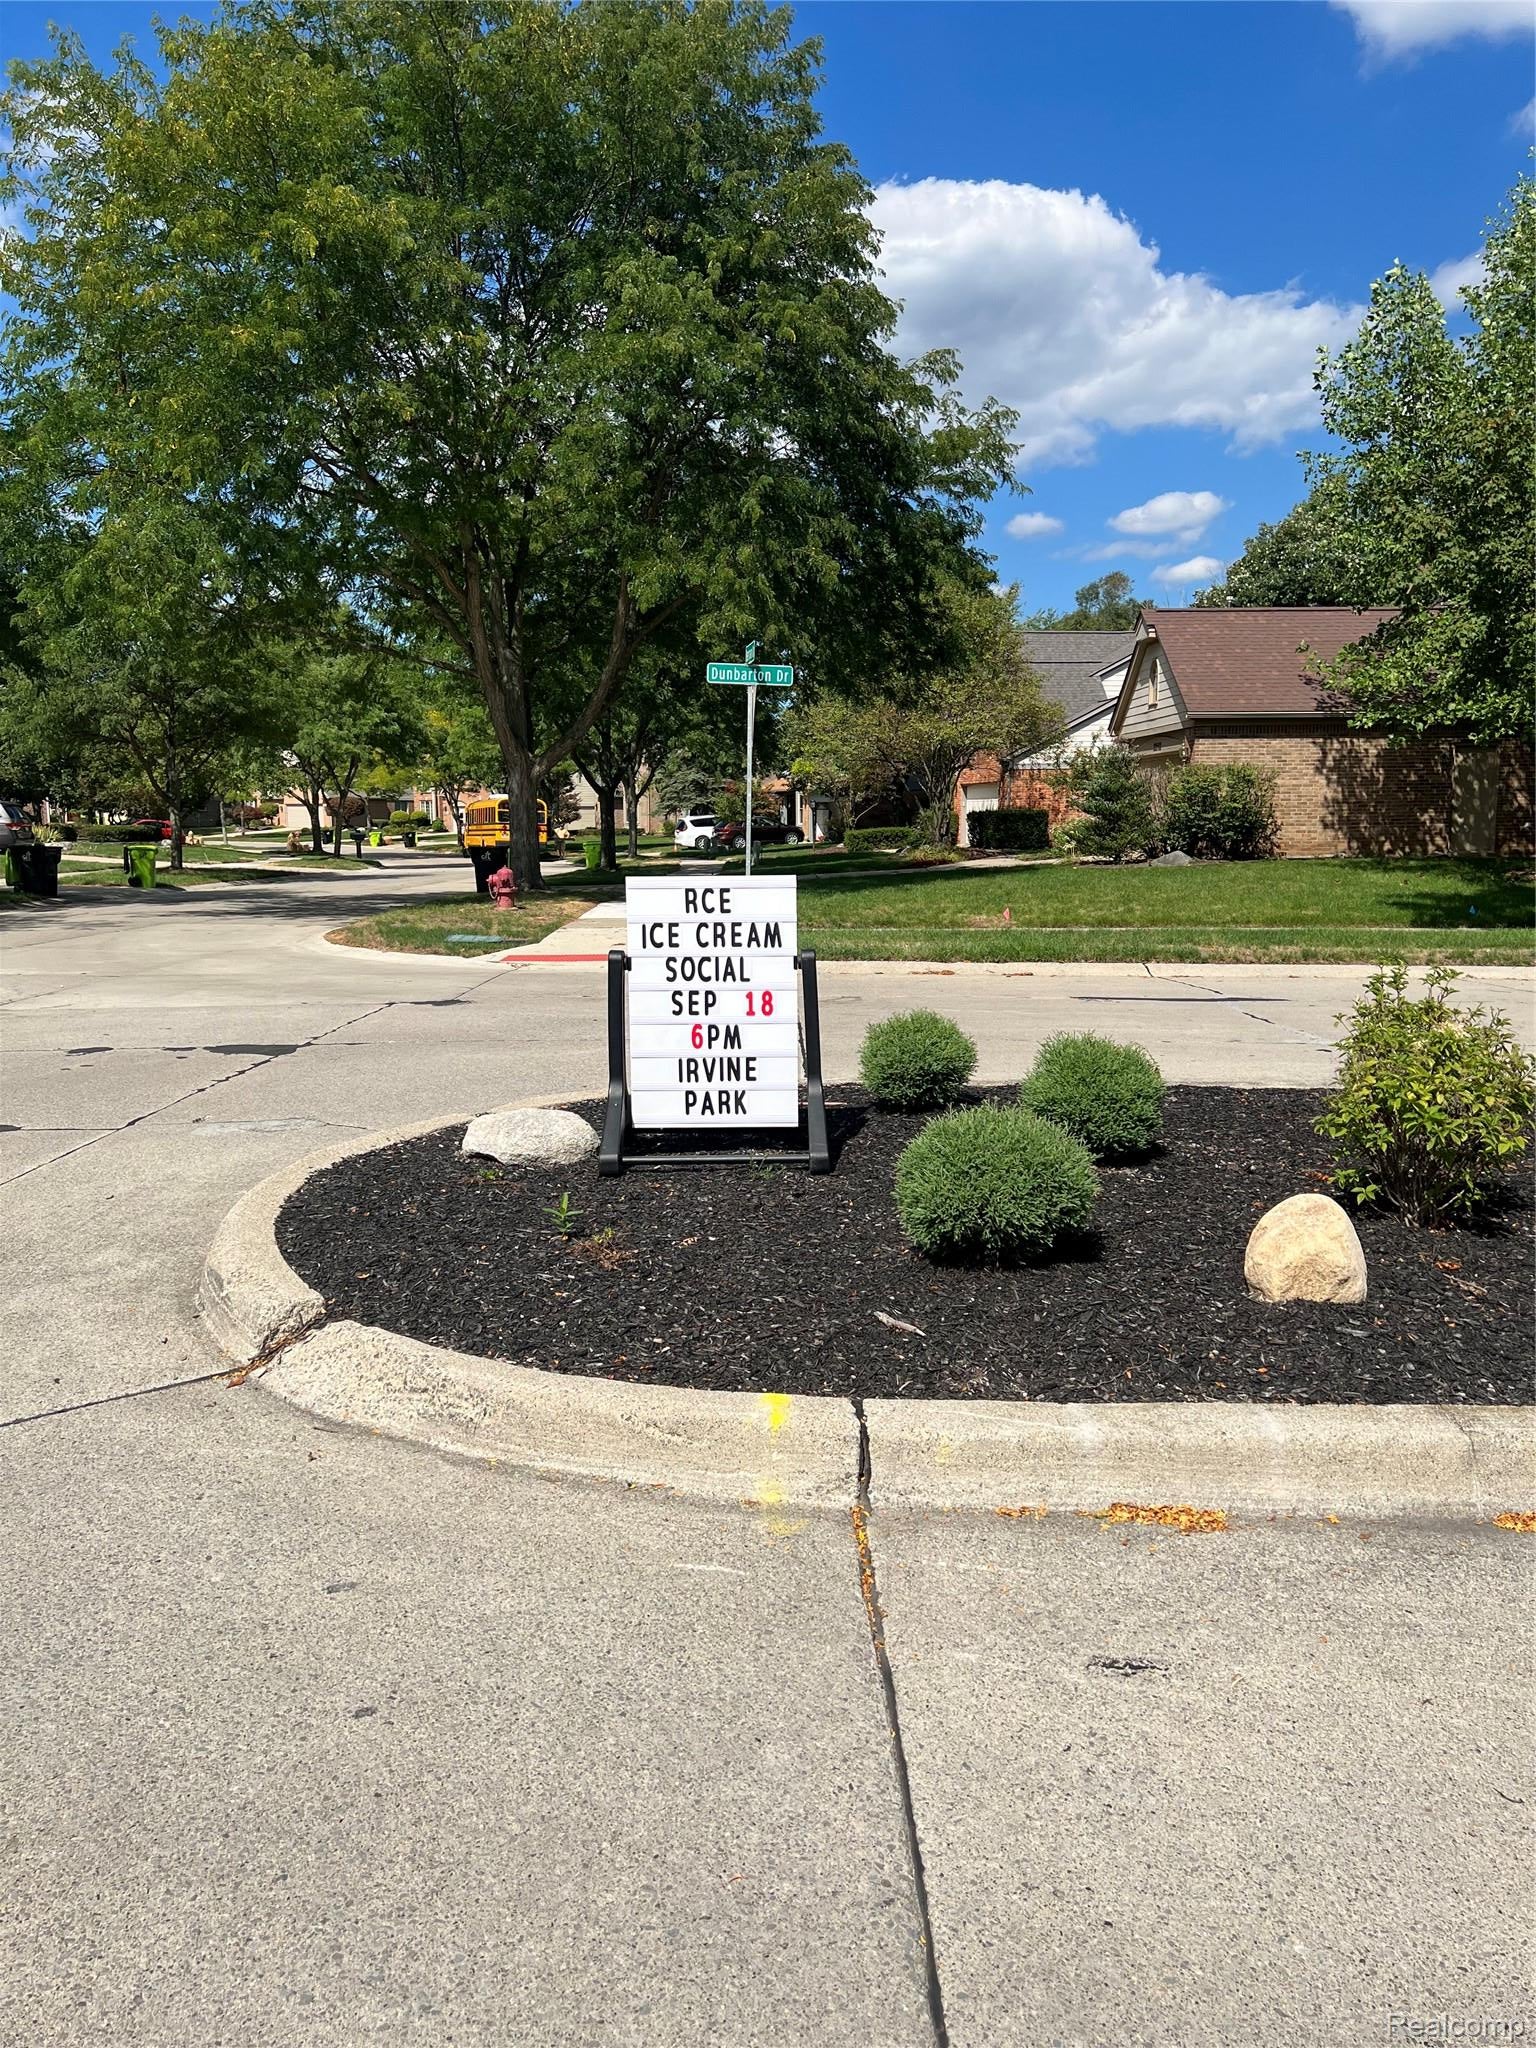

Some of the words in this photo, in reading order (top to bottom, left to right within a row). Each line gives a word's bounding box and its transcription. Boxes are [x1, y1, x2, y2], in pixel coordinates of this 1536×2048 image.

[711, 667, 771, 682] Dunbarton
[776, 670, 789, 682] Dr
[685, 887, 731, 914] RCE
[641, 922, 680, 949] ICE
[696, 922, 782, 948] CREAM
[665, 956, 750, 983] SOCIAL
[671, 990, 717, 1016] SEP
[745, 990, 774, 1017] 18
[691, 1023, 742, 1050] 6PM
[678, 1056, 757, 1083] IRVINE
[685, 1089, 747, 1115] PARK
